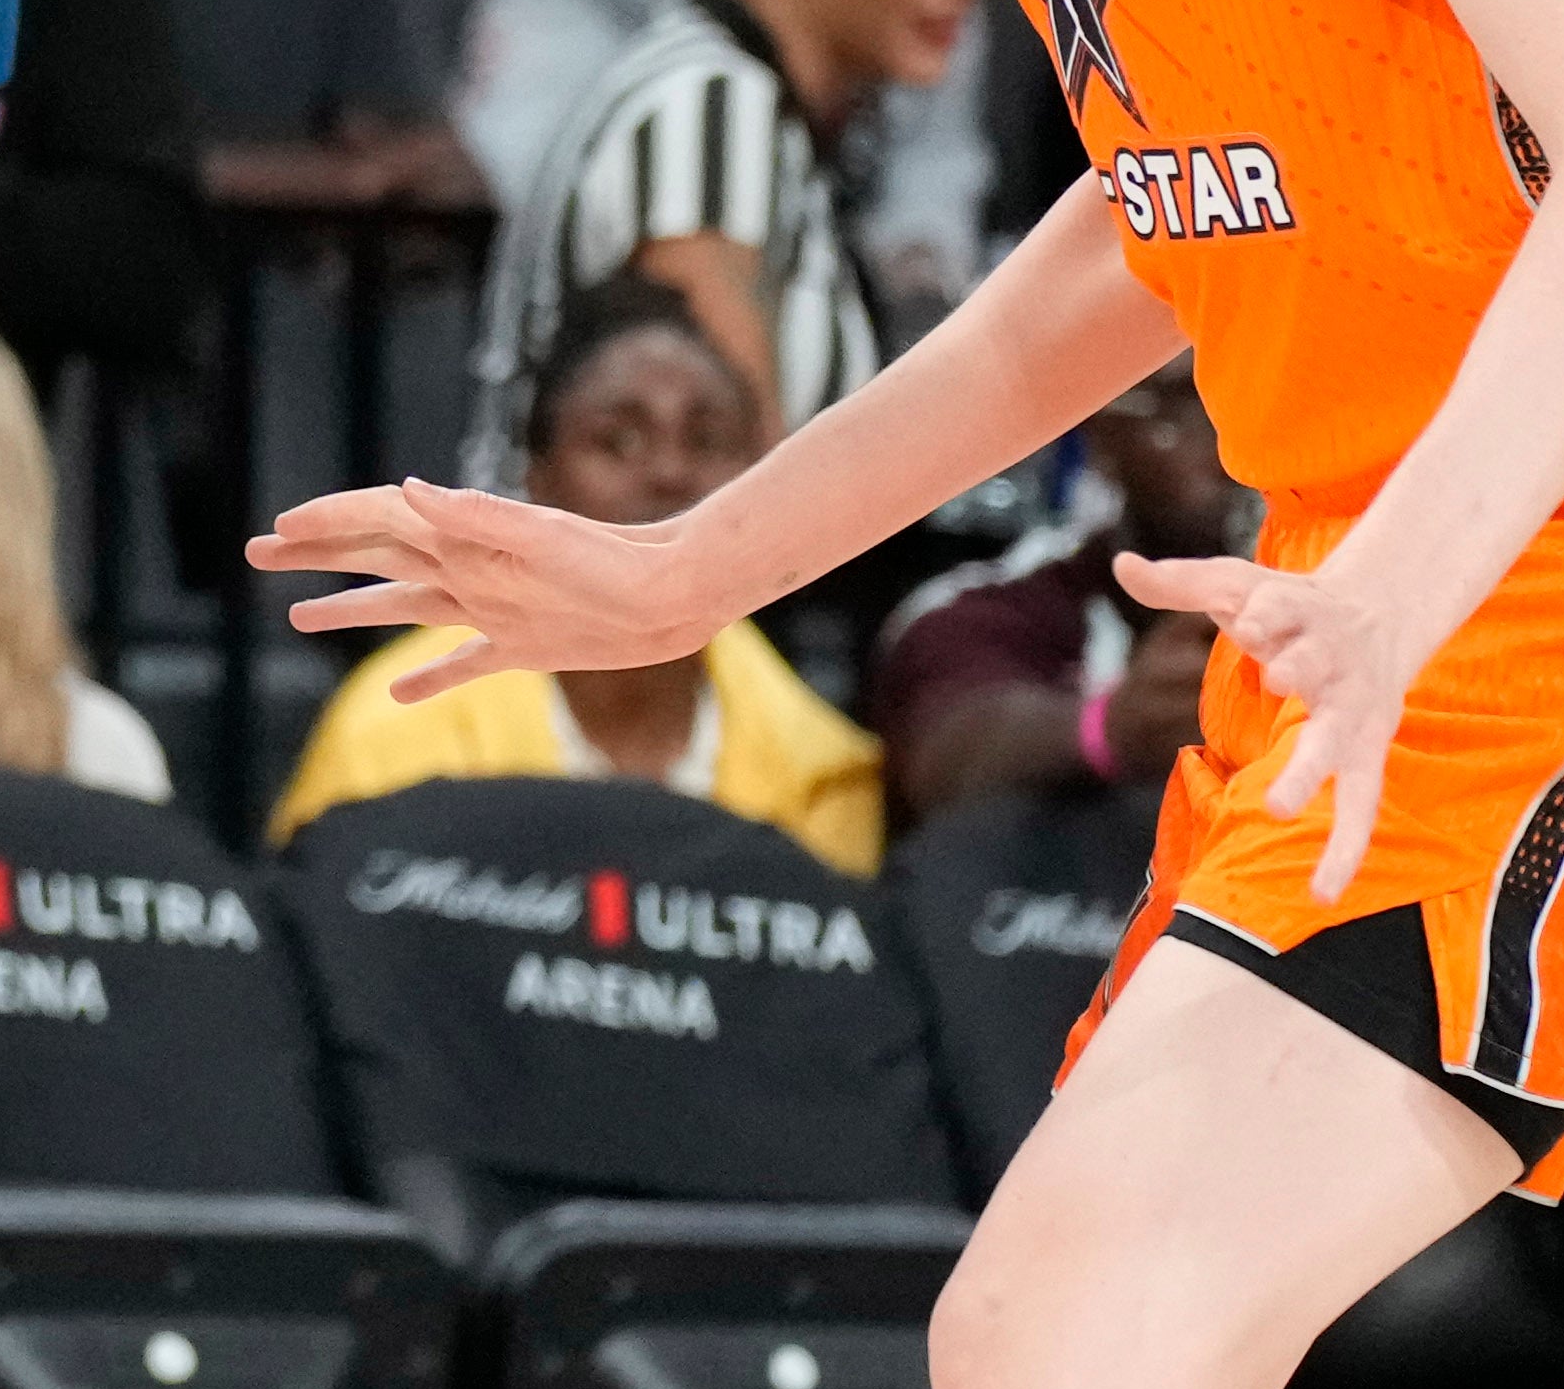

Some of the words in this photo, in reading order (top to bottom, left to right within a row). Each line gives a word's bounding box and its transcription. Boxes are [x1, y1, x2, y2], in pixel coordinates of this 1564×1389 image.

[16, 866, 261, 954] ULTRA
[635, 881, 876, 974] ULTRA
[504, 951, 719, 1041] ARENA
